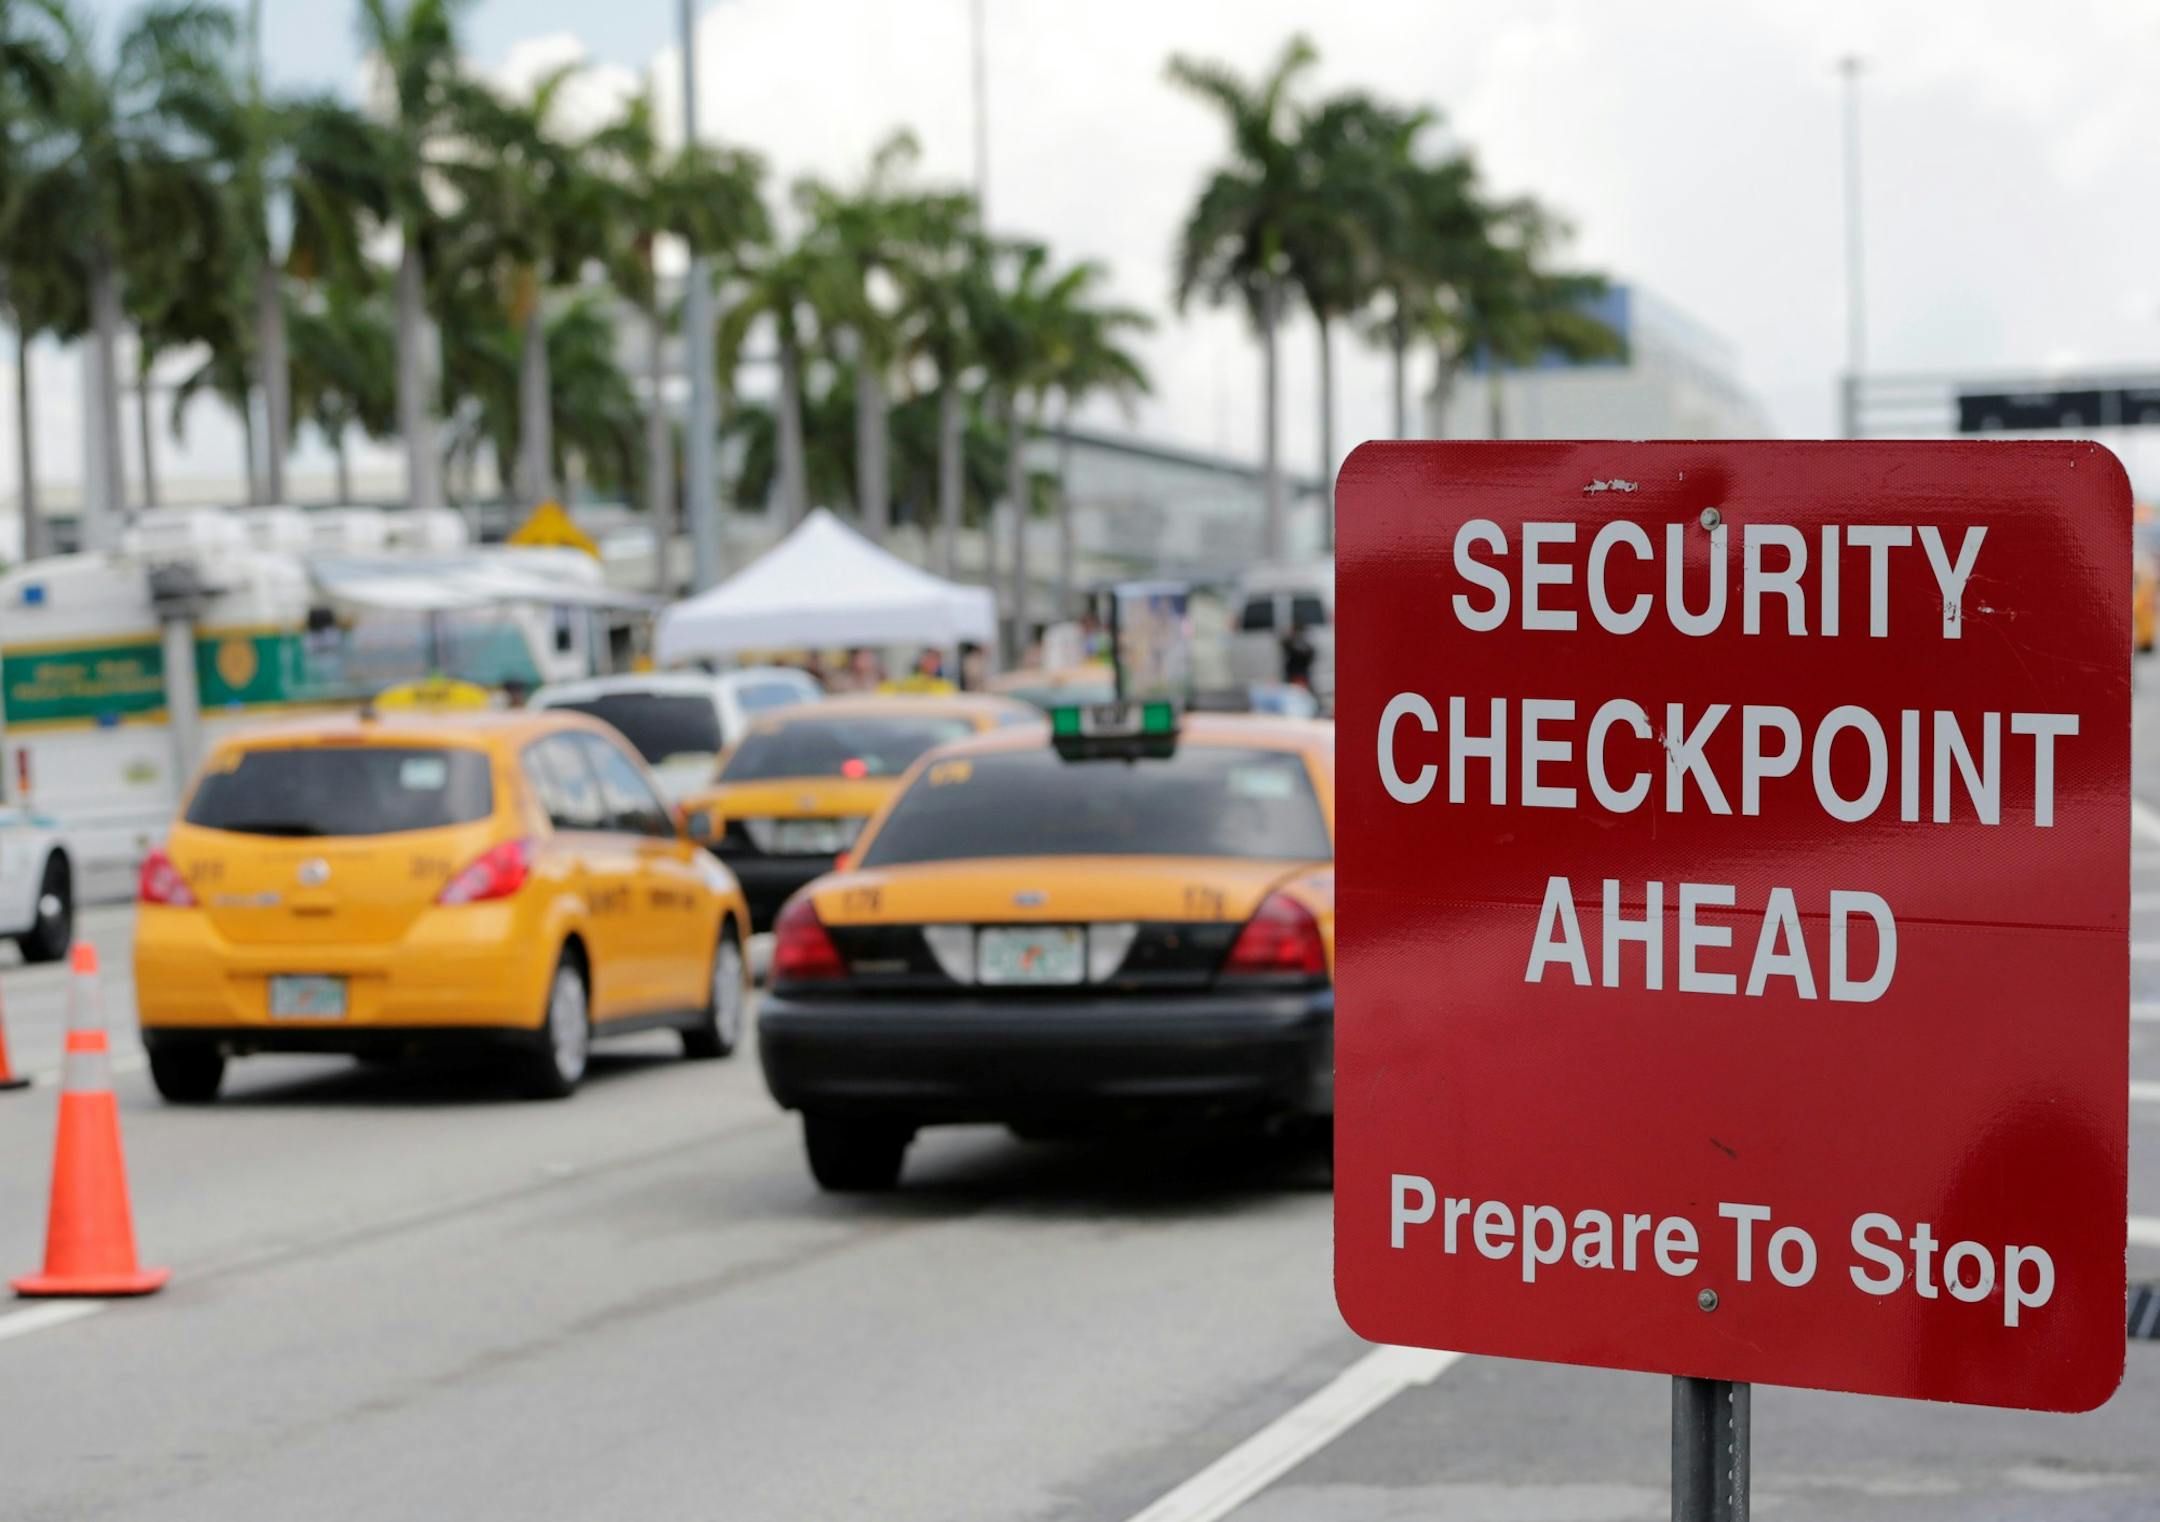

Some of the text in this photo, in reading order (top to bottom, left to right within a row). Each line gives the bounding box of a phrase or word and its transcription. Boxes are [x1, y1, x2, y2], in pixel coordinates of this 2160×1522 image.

[1452, 519, 1988, 639] SECURITY
[1377, 692, 2080, 828] CHECKPOINT
[1524, 876, 1898, 1003] AHEAD
[1391, 1173, 2055, 1327] Prepare To Stop
